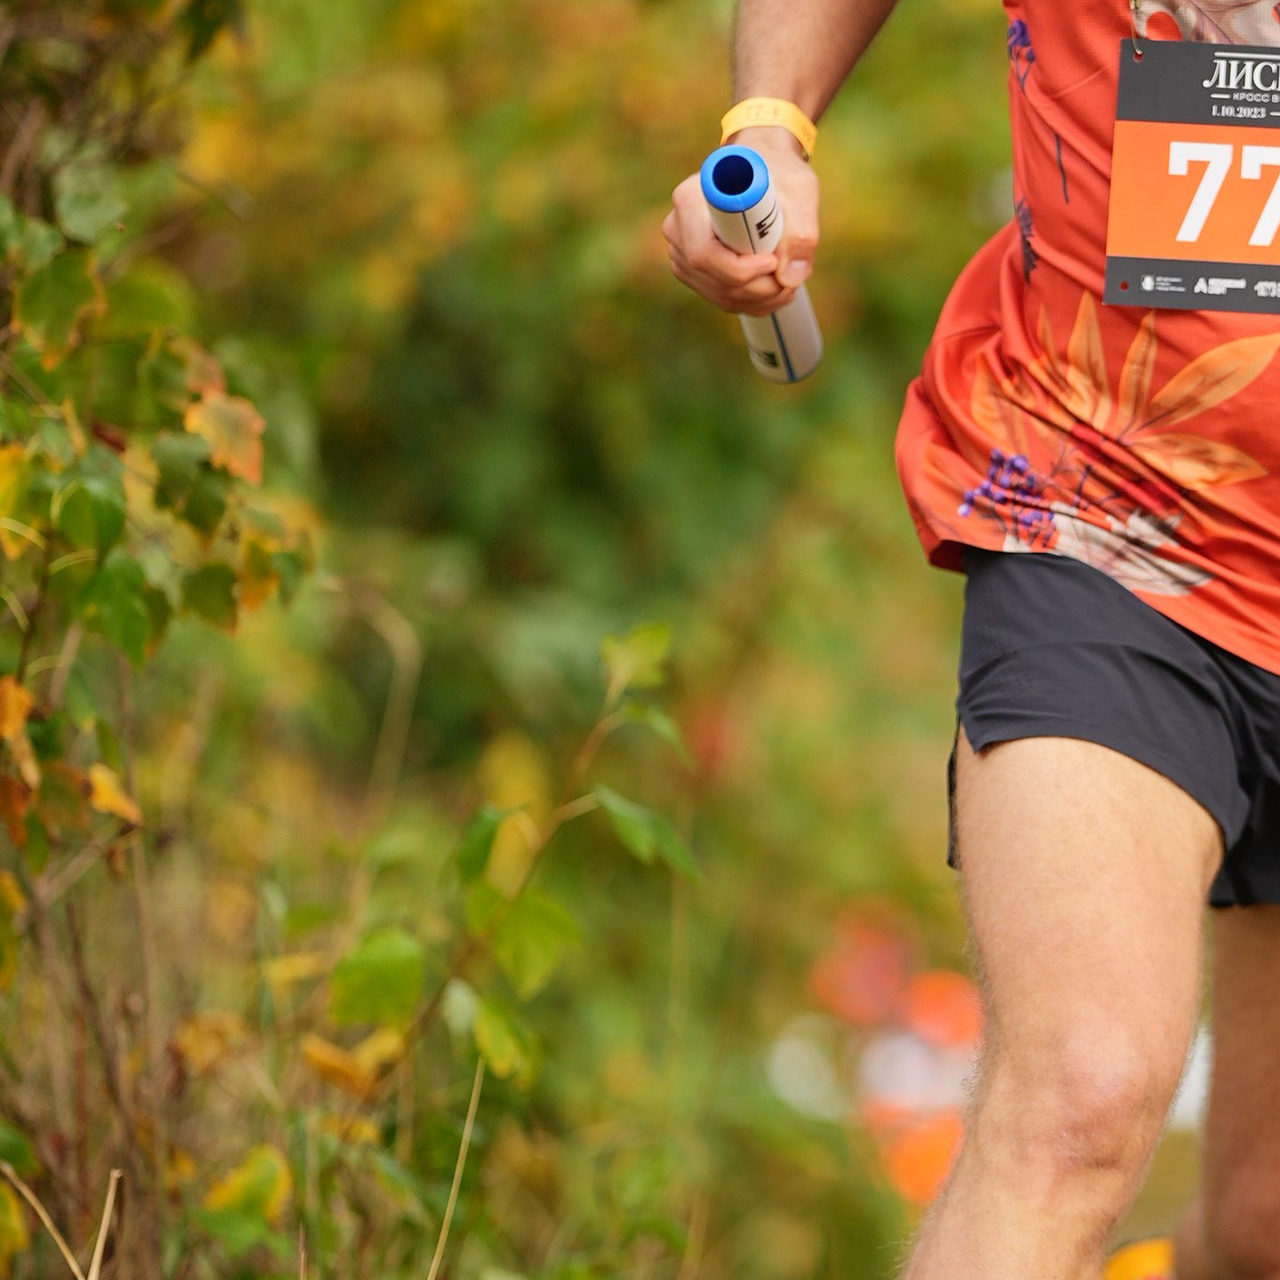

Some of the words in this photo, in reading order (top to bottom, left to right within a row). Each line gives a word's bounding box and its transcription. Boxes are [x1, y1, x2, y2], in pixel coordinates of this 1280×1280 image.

[1232, 93, 1271, 103] КРОСС
[1271, 94, 1280, 103] В
[1211, 105, 1267, 119] 1.10.2023
